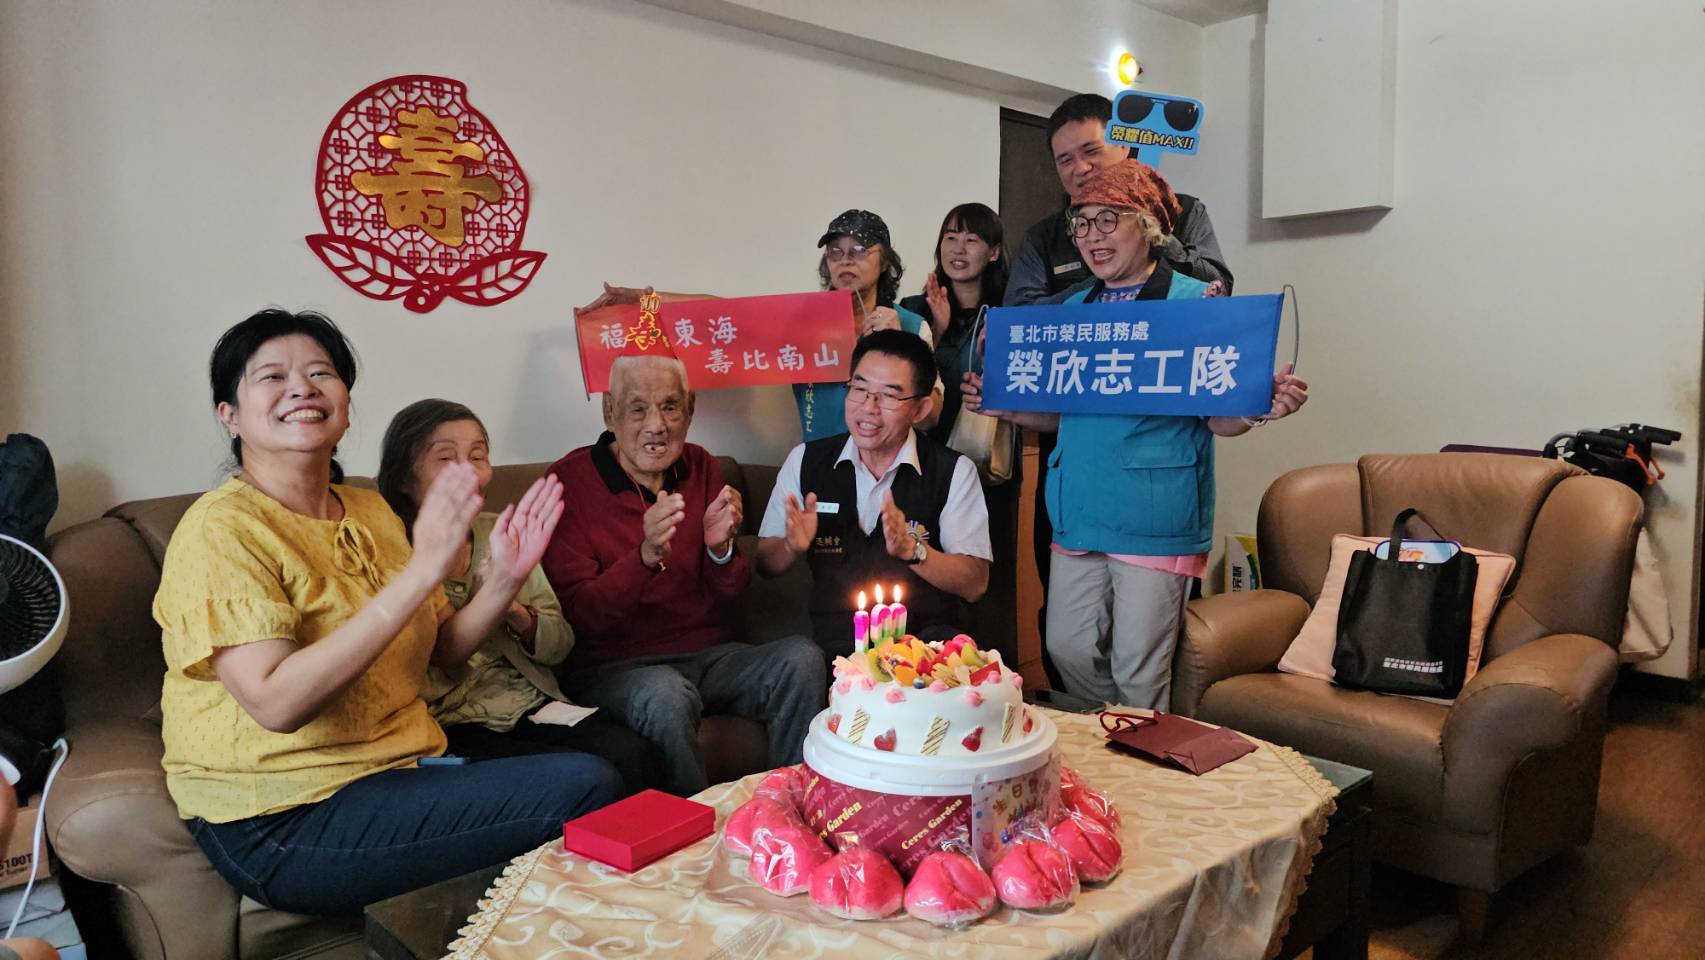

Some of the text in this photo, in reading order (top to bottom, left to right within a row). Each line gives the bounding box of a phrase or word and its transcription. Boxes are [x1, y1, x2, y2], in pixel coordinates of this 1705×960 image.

[351, 106, 502, 248] 壽
[600, 316, 738, 350] 福東海
[1009, 321, 1150, 343] 臺北市榮民服務處
[705, 342, 840, 375] 壽比南山
[1006, 344, 1241, 396] 榮欣志工隊
[826, 802, 863, 832] Garden
[901, 799, 963, 850] Ceres Garden
